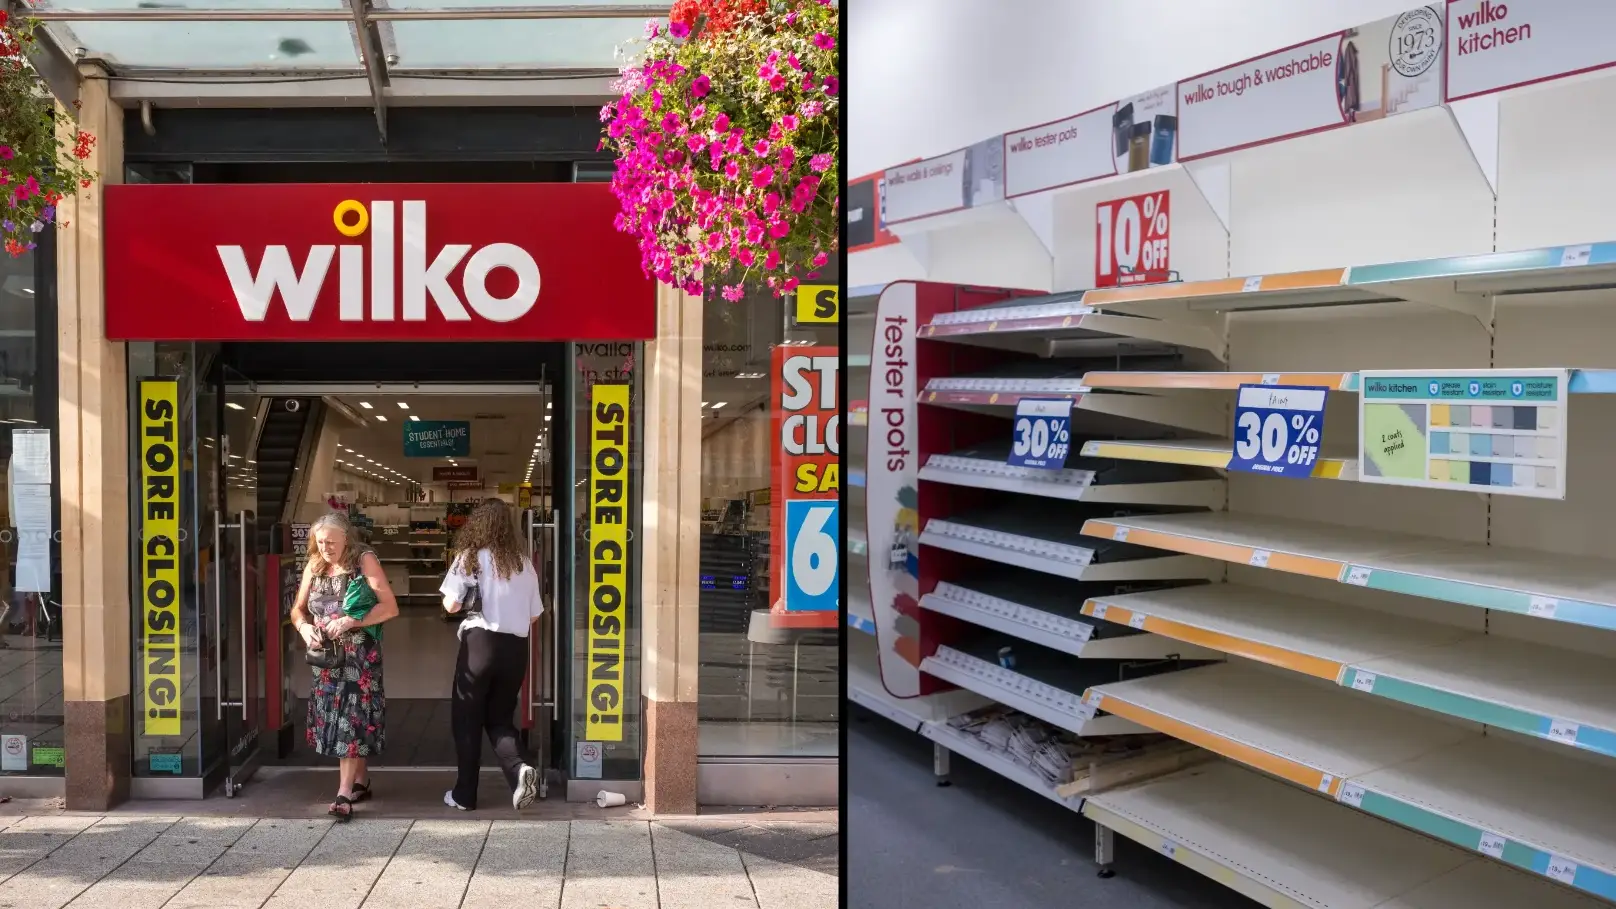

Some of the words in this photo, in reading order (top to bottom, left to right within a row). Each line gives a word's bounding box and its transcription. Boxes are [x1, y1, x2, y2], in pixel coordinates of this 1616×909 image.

[1397, 9, 1432, 29] DEVELOPING
[1457, 0, 1507, 30] wilko
[1396, 27, 1435, 56] 1973
[1458, 23, 1531, 56] kitchen
[1184, 84, 1215, 105] wilko
[1217, 72, 1251, 97] tough
[1254, 69, 1264, 86] &
[1265, 51, 1333, 82] washable
[1010, 136, 1034, 153] wilko
[1035, 131, 1058, 148] tester
[1058, 126, 1078, 145] pots
[1097, 193, 1168, 276] 10%
[216, 199, 542, 323] wilko
[1142, 238, 1168, 271] OFF
[884, 314, 909, 398] tester
[1368, 381, 1387, 392] wilko
[1388, 383, 1418, 393] kitchen
[408, 429, 443, 442] STUDENT
[445, 427, 467, 439] HOME
[881, 406, 910, 472] pots
[1013, 417, 1069, 458] 30%
[1047, 442, 1068, 459] OFF
[1236, 411, 1319, 462] 30%
[1383, 439, 1405, 456] applied
[145, 398, 175, 521] STORE
[596, 401, 625, 526] STORE
[1287, 444, 1318, 466] OFF
[146, 540, 178, 719] CLOSING!
[590, 538, 622, 724] CLOSING!
